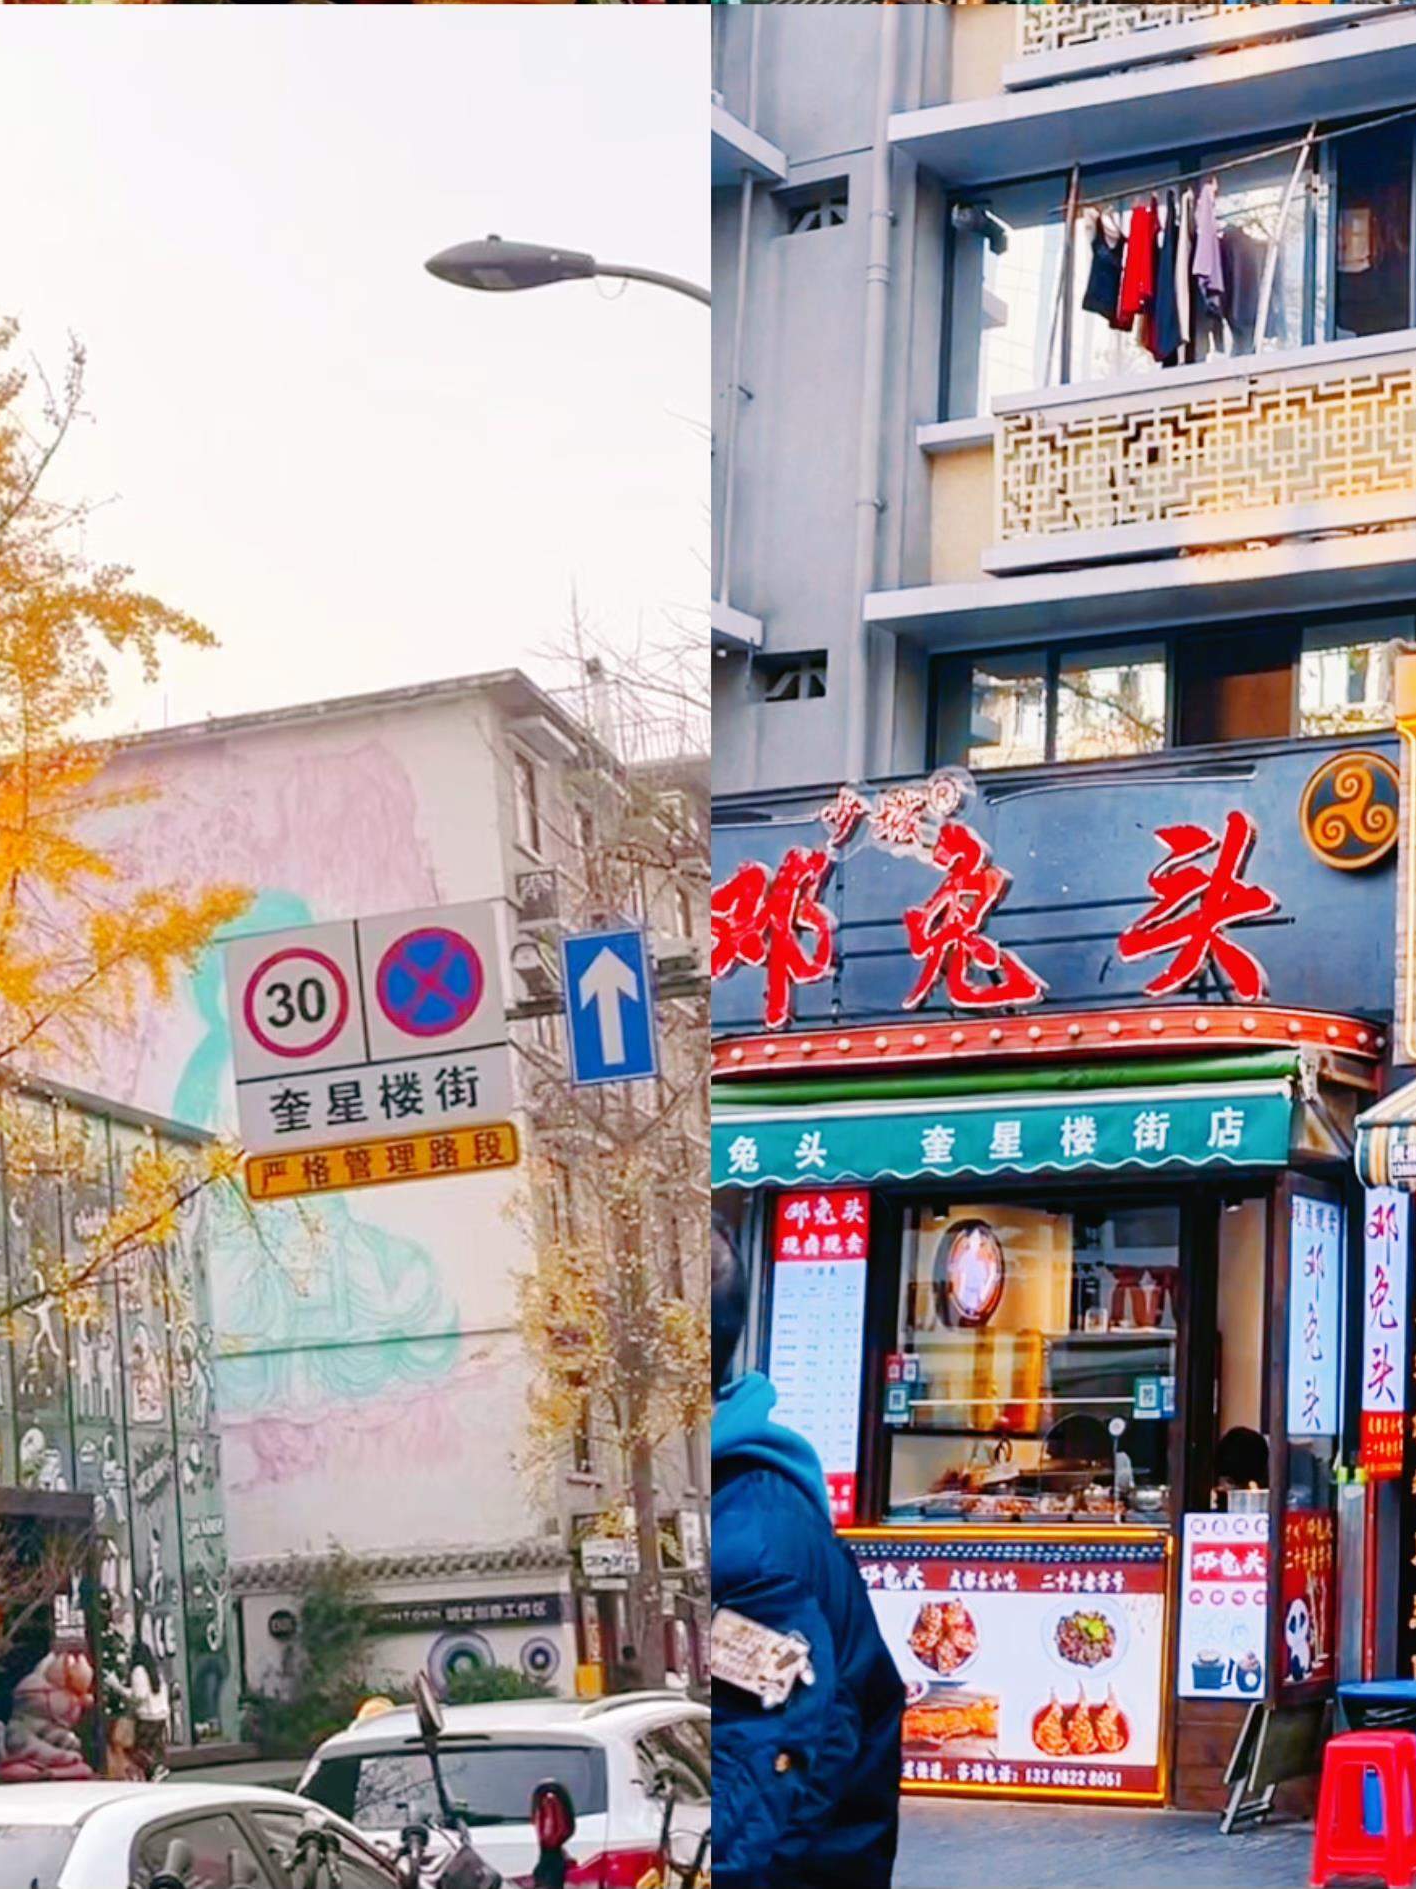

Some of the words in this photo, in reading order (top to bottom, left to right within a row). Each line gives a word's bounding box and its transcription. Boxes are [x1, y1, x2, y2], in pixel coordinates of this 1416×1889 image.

[266, 978, 326, 1028] 30
[269, 1065, 481, 1134] 奎星楼街
[260, 1132, 505, 1193] 严格管理路段
[728, 1129, 829, 1174] 兔头
[920, 1106, 1247, 1165] 奎星楼街店
[1365, 1207, 1399, 1403] 邓兔头
[1025, 1768, 1049, 1785] 133
